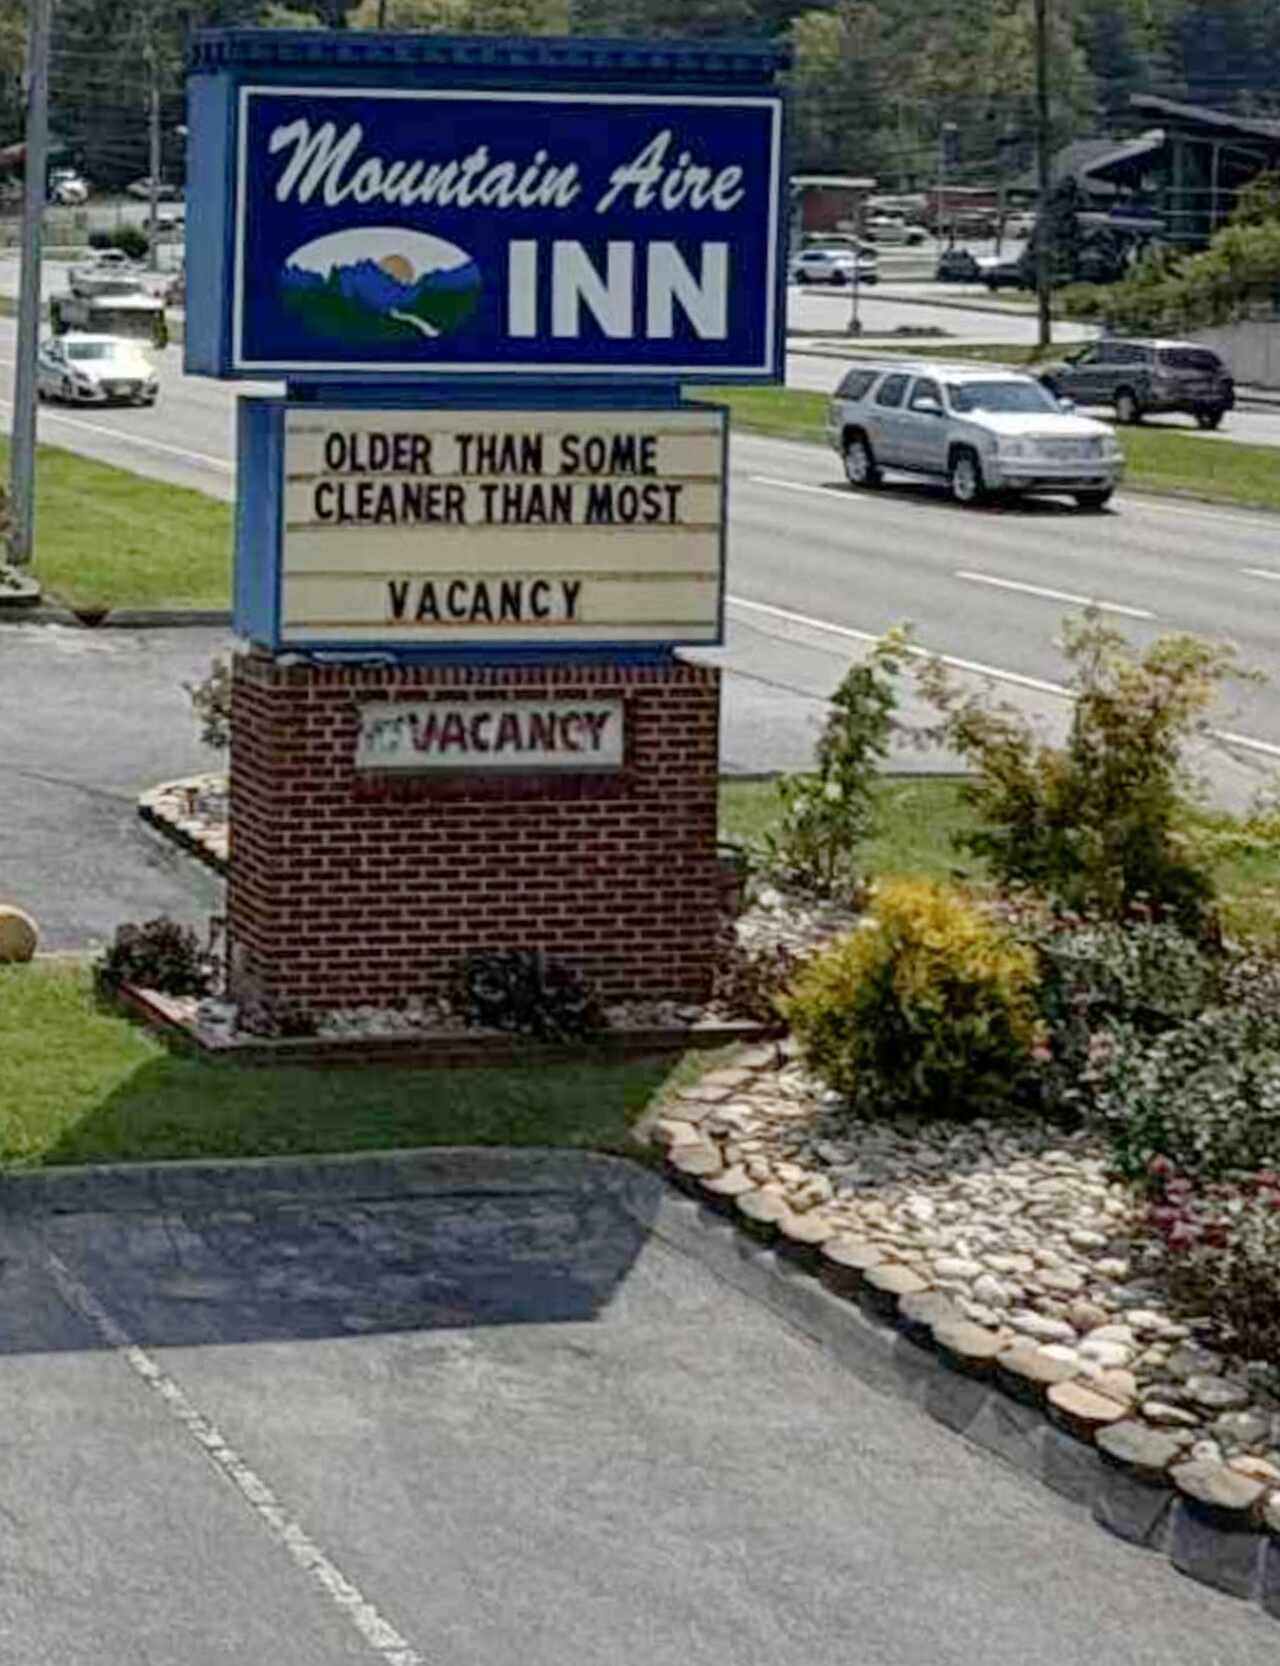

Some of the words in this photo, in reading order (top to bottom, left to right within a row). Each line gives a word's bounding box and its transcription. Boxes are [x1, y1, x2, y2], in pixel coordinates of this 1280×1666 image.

[269, 118, 581, 209] Mountain
[596, 130, 746, 213] Aire
[507, 239, 729, 339] INN
[324, 432, 432, 475] OLDER
[455, 433, 541, 475] THAN
[560, 435, 659, 475] SOME
[314, 482, 465, 524] CLEANER
[479, 483, 573, 525] THAN
[585, 483, 683, 525] MOST
[388, 579, 583, 622] VACANCY
[406, 710, 613, 753] VACANCY
